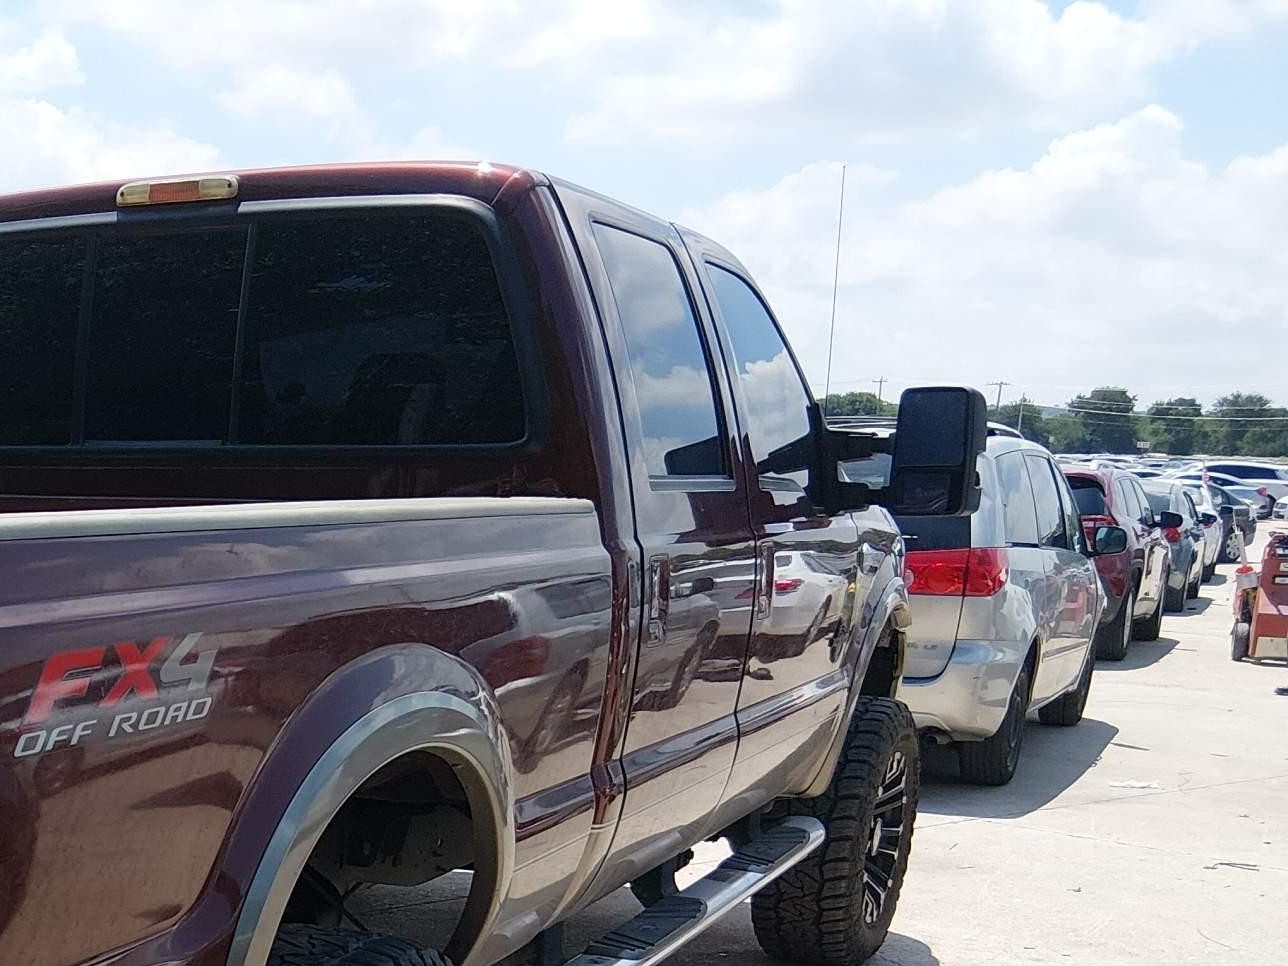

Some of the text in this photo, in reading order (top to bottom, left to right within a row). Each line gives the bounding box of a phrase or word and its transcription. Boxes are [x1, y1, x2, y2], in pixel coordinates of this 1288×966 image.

[22, 631, 219, 730] FX4
[13, 697, 213, 758] OFF ROAD
